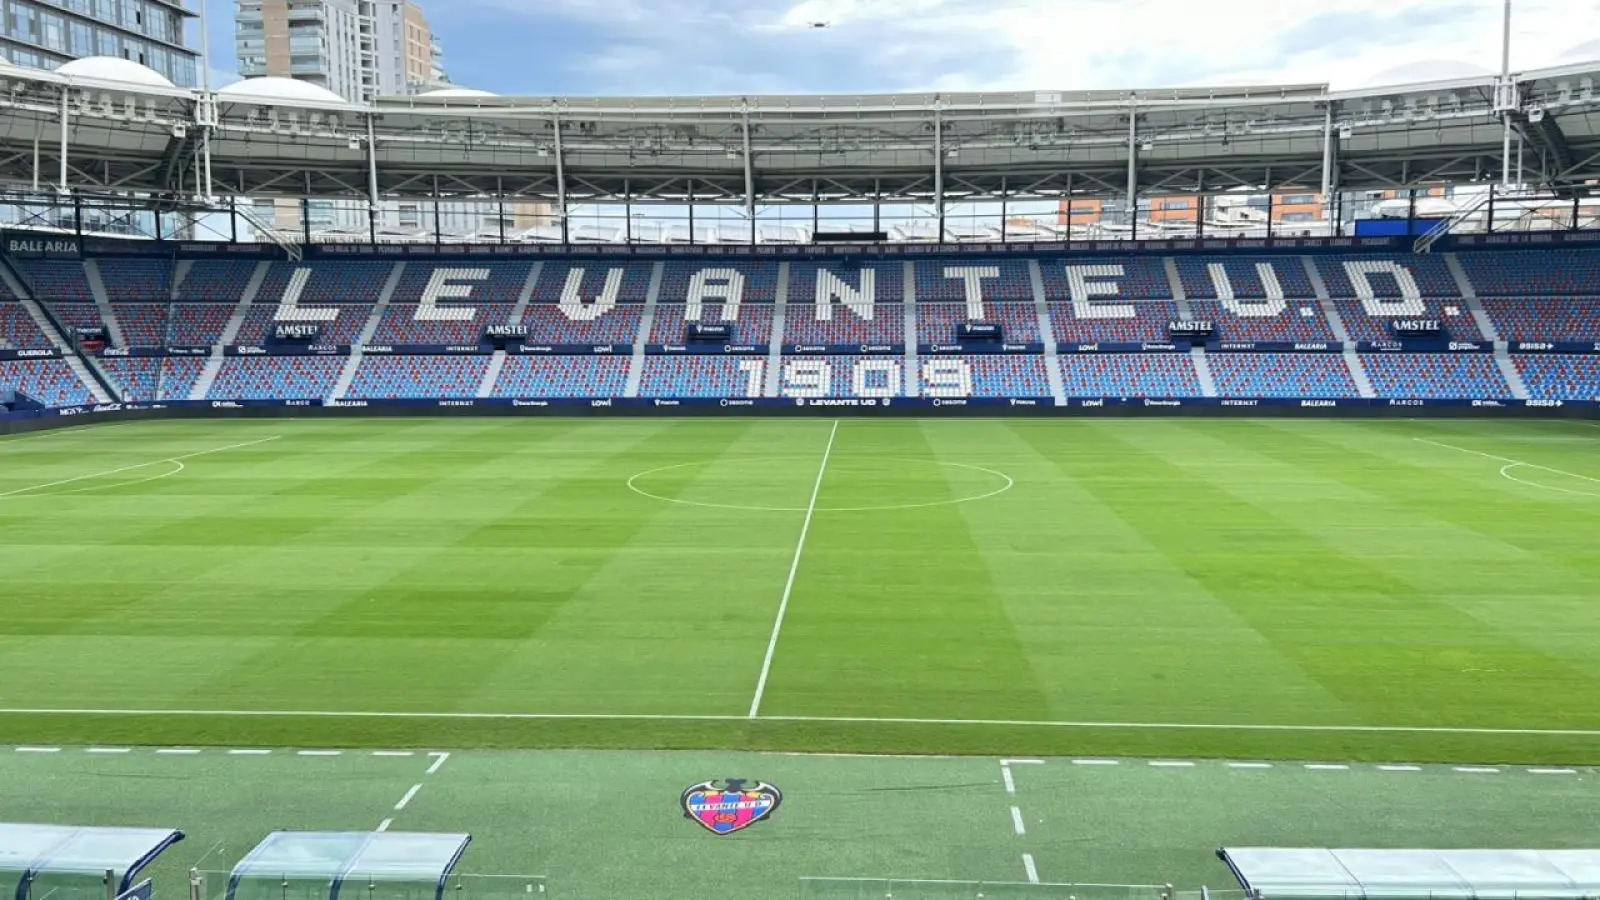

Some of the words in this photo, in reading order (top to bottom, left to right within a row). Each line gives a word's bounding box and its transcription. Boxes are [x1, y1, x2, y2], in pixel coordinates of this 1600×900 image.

[9, 240, 78, 253] BALEARIA
[273, 264, 1136, 321] LEVANTE
[1169, 320, 1214, 331] AMSTEL
[1392, 320, 1442, 331] AMSTEL
[739, 358, 972, 397] 1909
